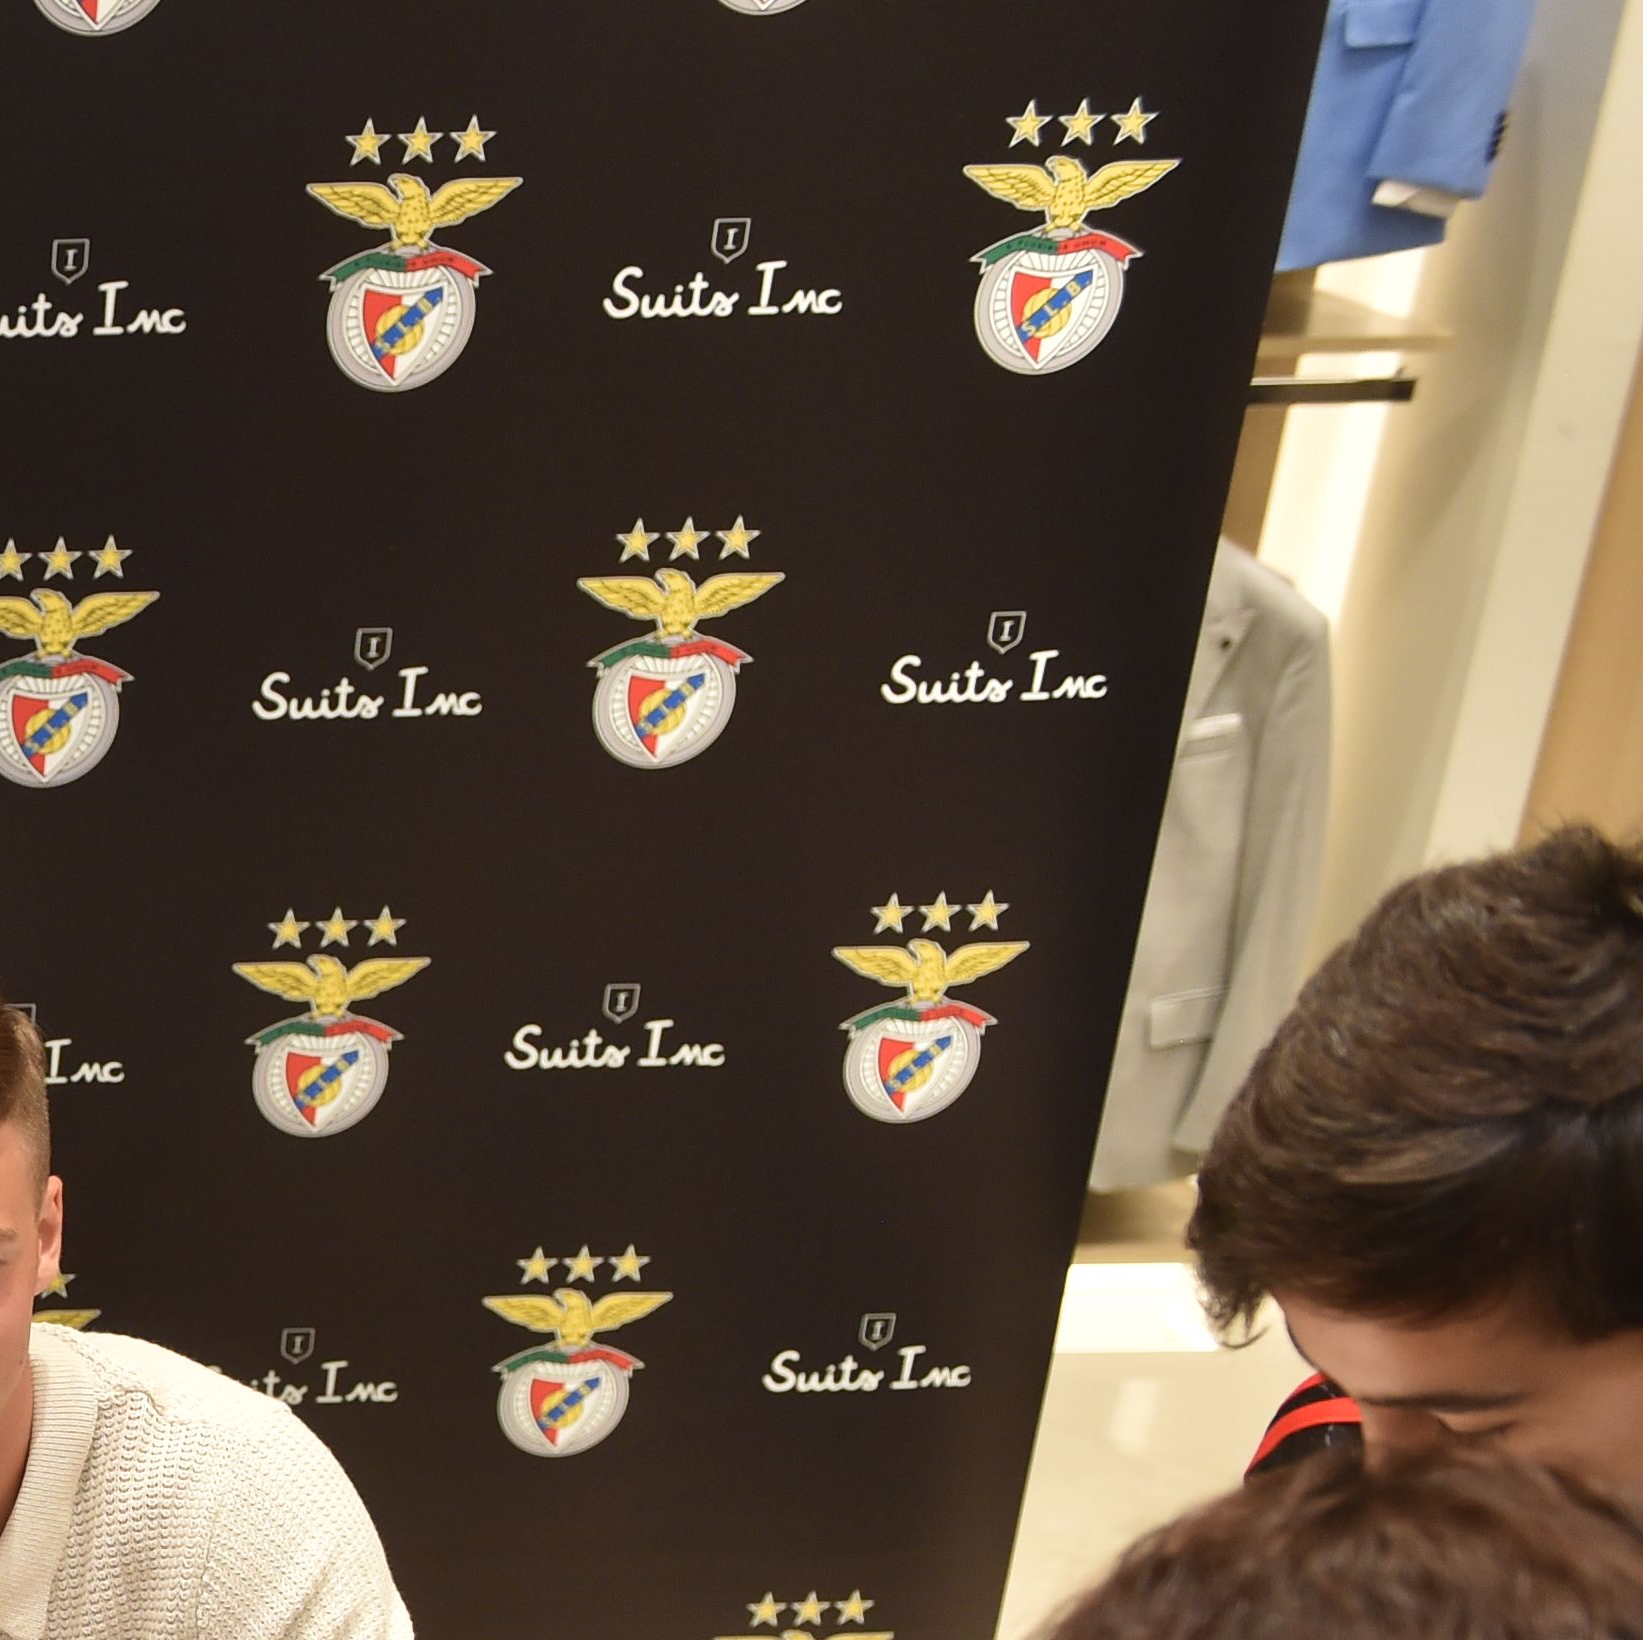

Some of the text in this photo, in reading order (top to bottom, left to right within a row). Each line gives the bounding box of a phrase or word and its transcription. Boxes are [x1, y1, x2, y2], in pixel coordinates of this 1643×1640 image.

[93, 281, 186, 335] Inc
[603, 261, 842, 318] Suits Inc
[253, 667, 482, 719] Suits Inc
[881, 650, 1107, 703] Suits Inc
[44, 1038, 125, 1084] Inc
[505, 1020, 724, 1069] Suits Inc
[316, 1360, 398, 1403] Inc
[763, 1346, 971, 1392] Suits Inc
